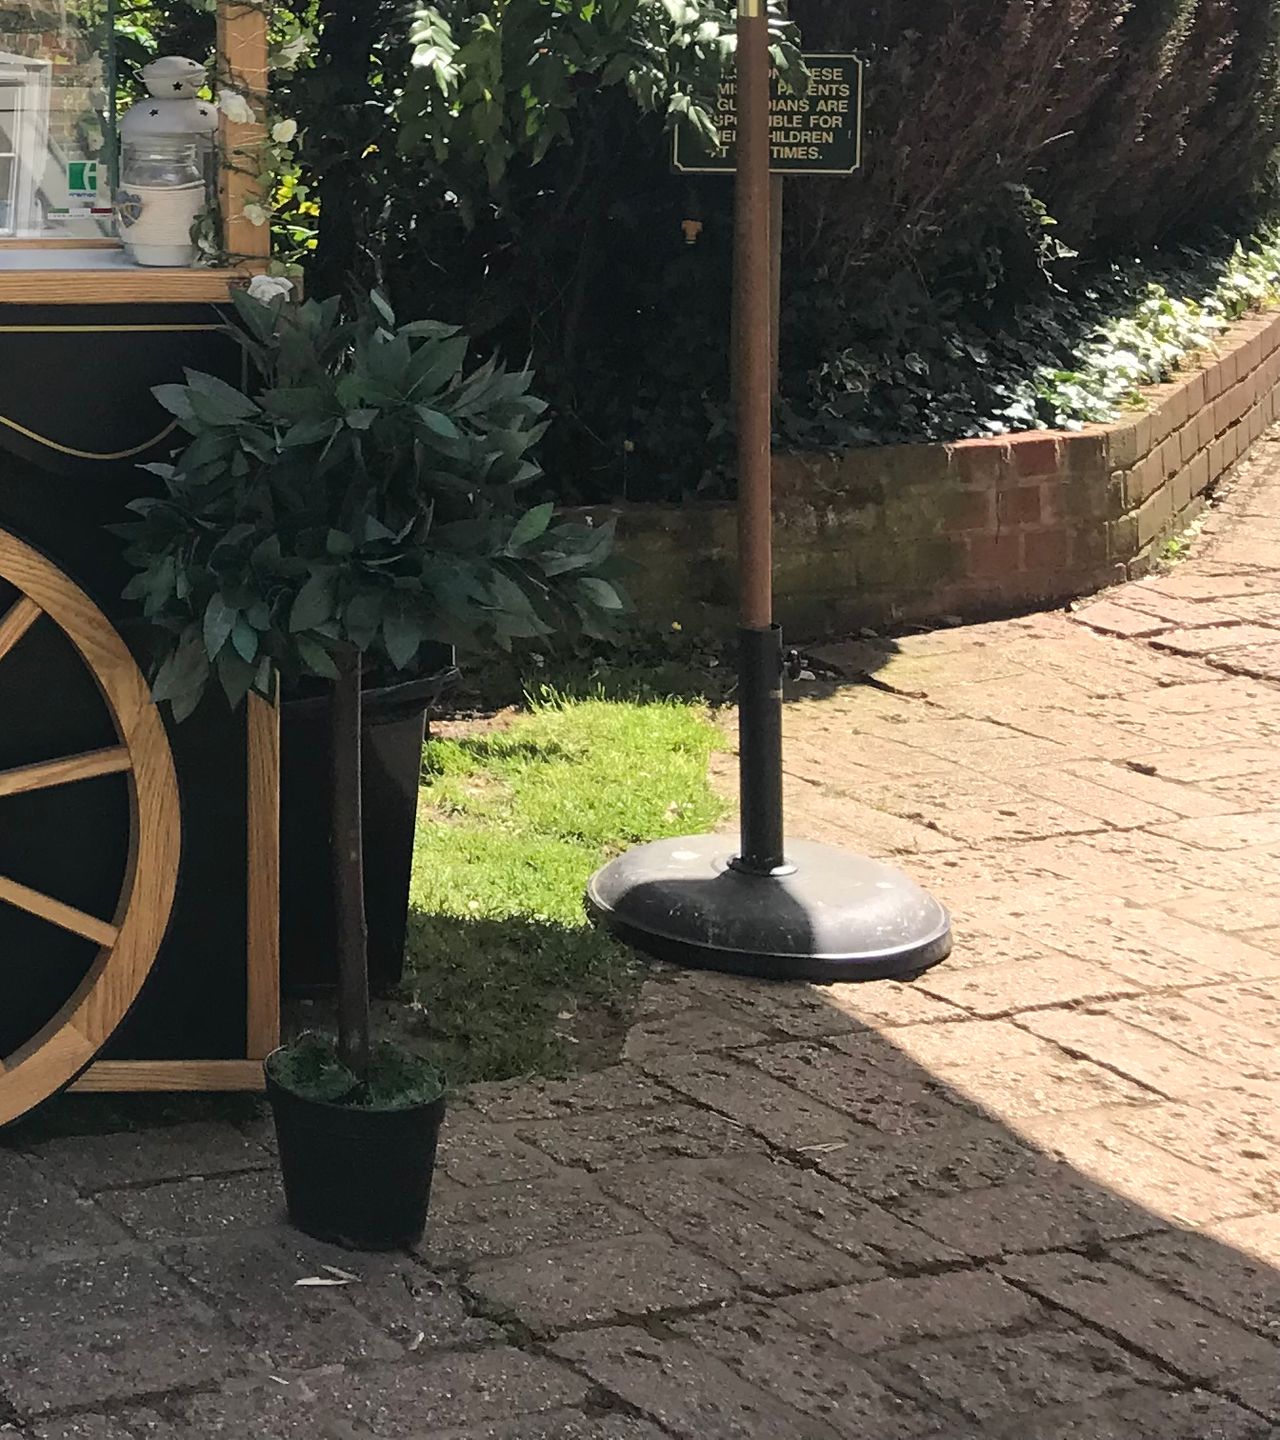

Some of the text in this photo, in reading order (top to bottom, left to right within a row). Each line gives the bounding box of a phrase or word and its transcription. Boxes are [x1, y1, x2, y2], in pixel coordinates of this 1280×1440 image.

[778, 84, 850, 96] PAENTS
[816, 100, 849, 112] ARE
[810, 115, 843, 128] FOR
[768, 131, 834, 143] HILDREN
[771, 146, 823, 159] TIMES.
